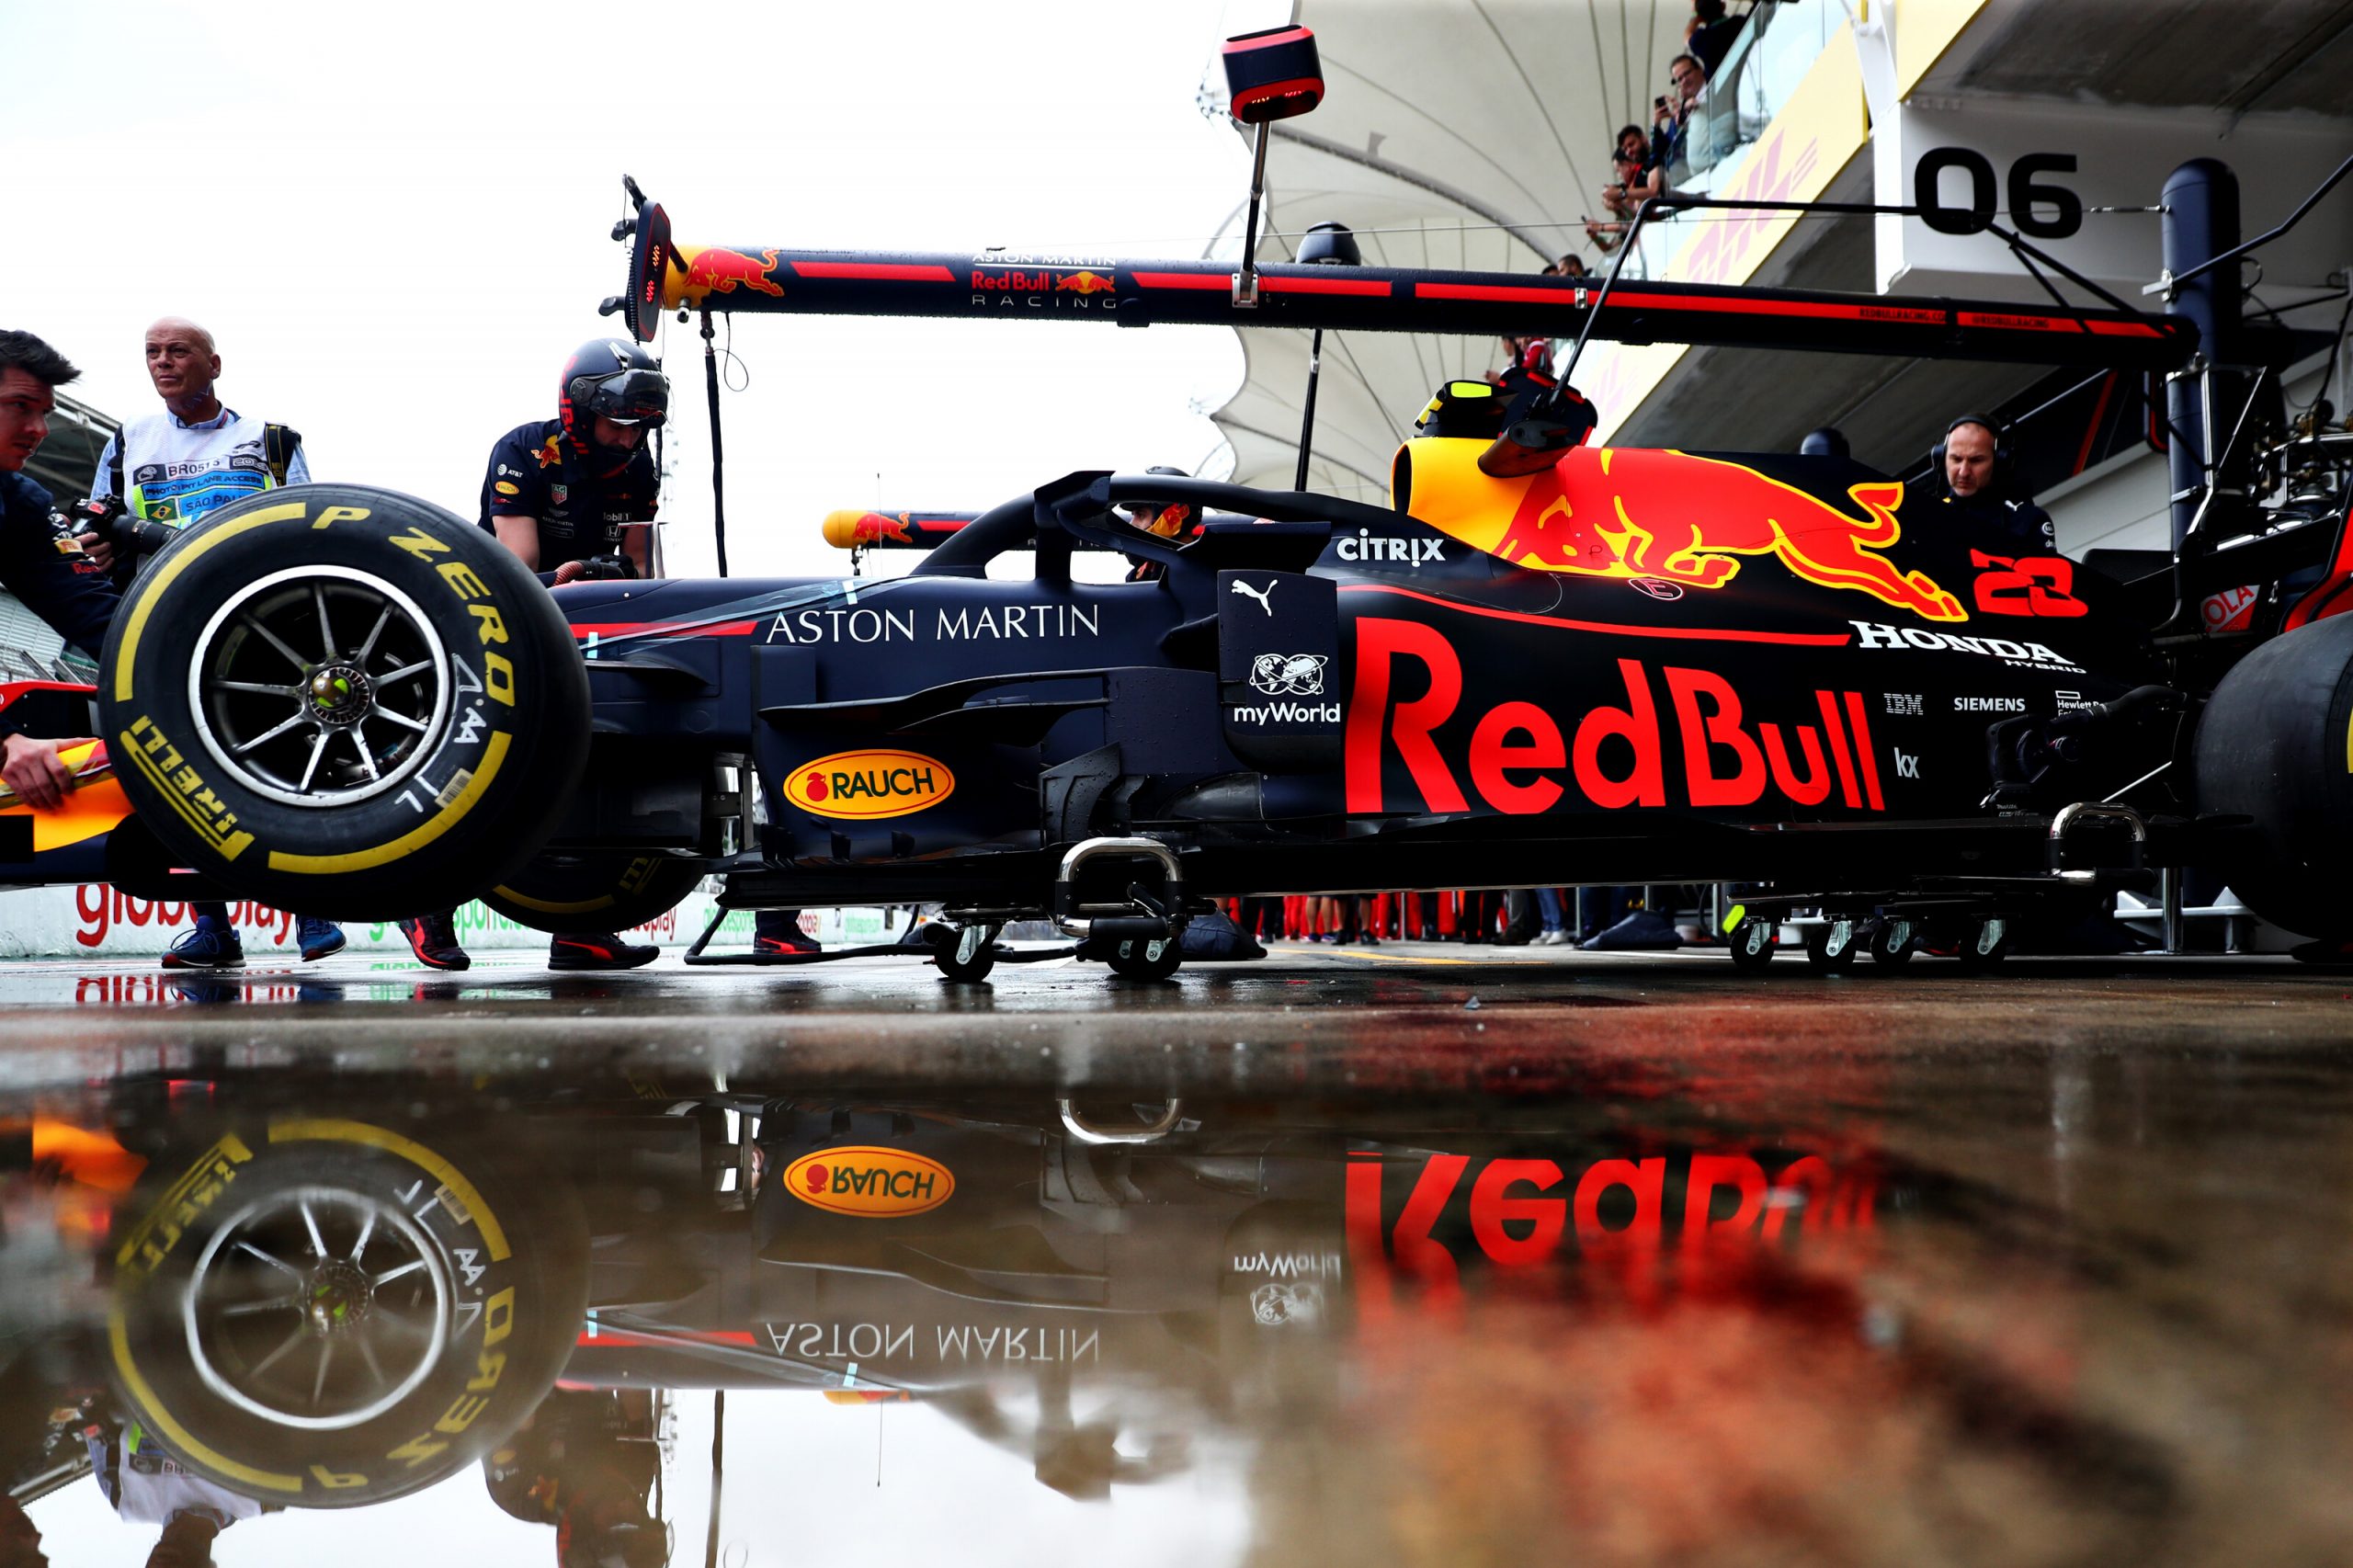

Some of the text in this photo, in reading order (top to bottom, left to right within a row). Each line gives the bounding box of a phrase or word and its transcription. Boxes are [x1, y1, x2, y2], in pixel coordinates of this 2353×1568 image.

[1915, 147, 2083, 238] 06
[972, 254, 1117, 266] ASTON MARTIN
[972, 271, 1050, 290] Red Bull
[972, 295, 1117, 309] RACING
[507, 469, 523, 478] AT&T
[186, 496, 211, 512] SÃO
[1971, 549, 2089, 618] 23
[312, 506, 516, 707] P ZERO
[765, 604, 1098, 643] ASTON MARTIN
[1848, 620, 2075, 665] HONDA
[2005, 659, 2086, 674] HYBRID
[1233, 701, 1341, 726] myWorld
[1884, 693, 1924, 715] IBM
[1954, 698, 2026, 711] SIEMENS
[2057, 699, 2091, 710] Hewlett
[1893, 747, 1920, 778] kx
[120, 715, 255, 862] PIRELLI
[832, 767, 936, 800] RAUCH
